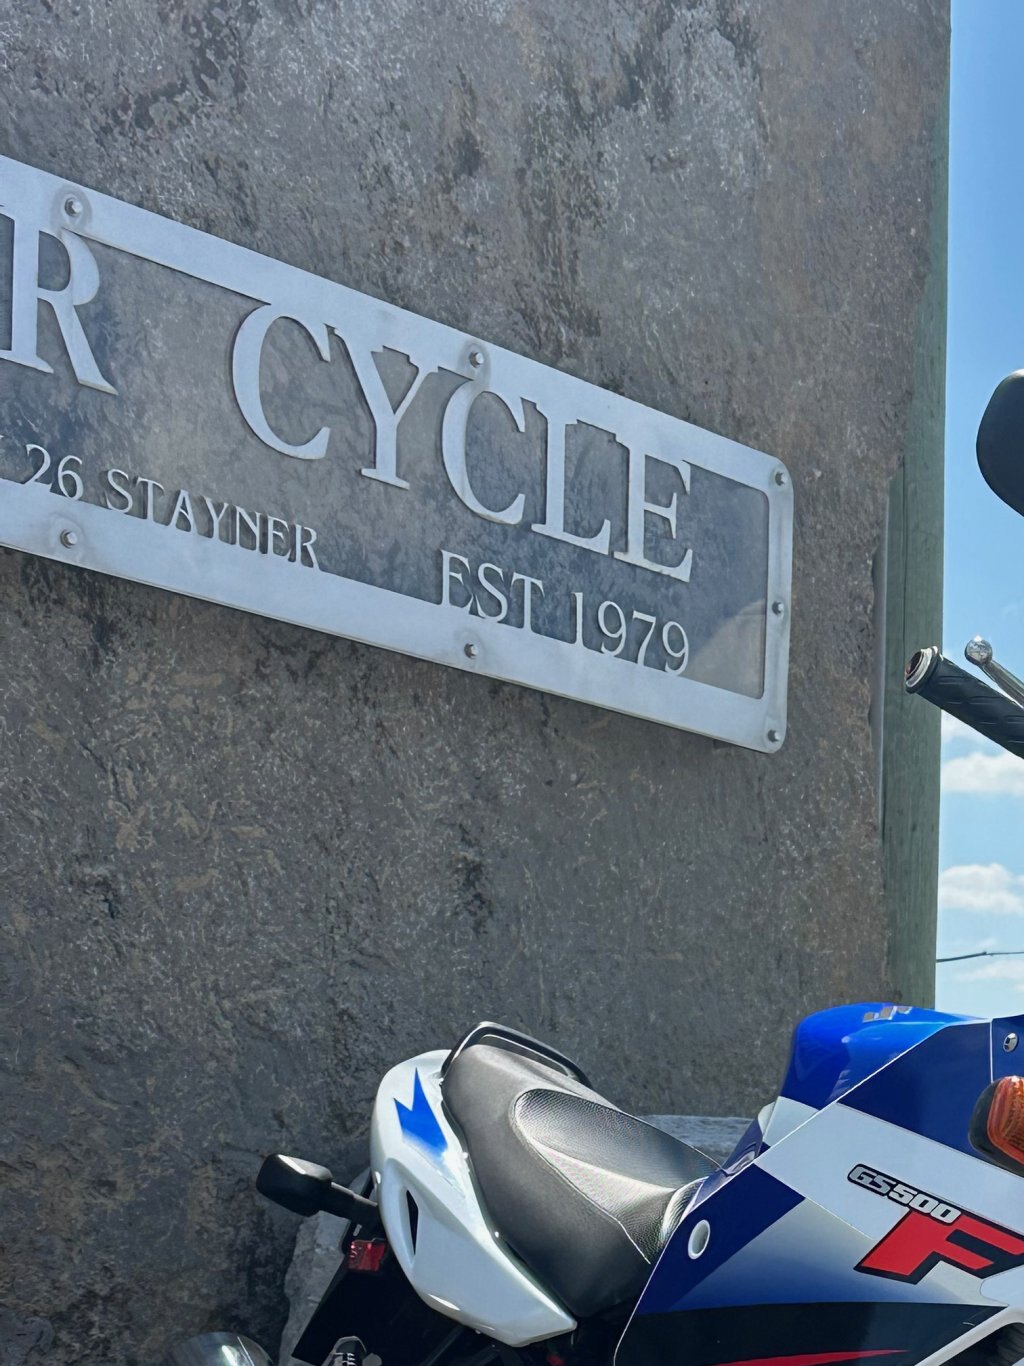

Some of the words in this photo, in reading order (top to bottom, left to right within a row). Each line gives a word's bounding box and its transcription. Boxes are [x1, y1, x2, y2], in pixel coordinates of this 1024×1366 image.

[231, 302, 692, 583] CYCLE
[25, 443, 84, 501] 26
[105, 468, 321, 571] STAYNER
[438, 549, 544, 632] EST
[573, 592, 690, 677] 1979
[847, 1163, 963, 1226] GS500
